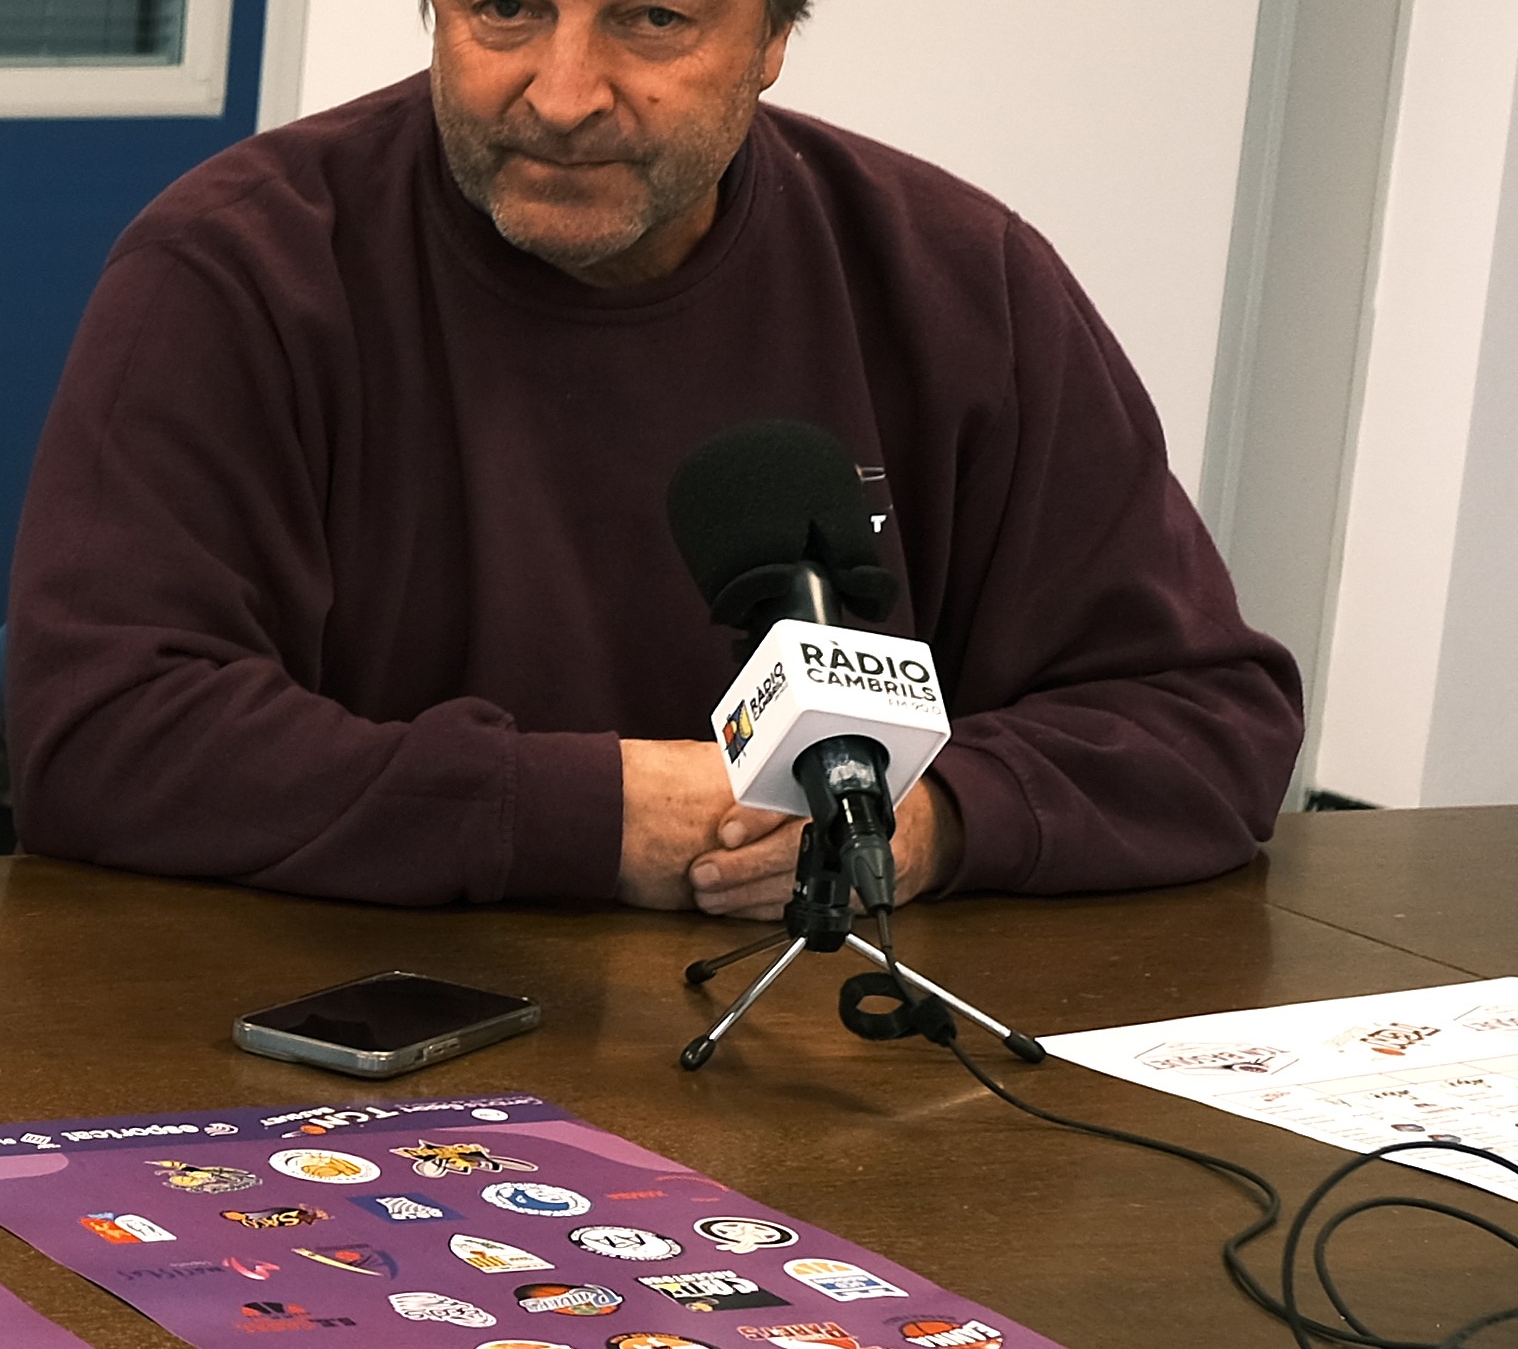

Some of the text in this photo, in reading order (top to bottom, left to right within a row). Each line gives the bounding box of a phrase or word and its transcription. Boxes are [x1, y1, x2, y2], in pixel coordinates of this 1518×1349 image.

[800, 640, 931, 684] RÀDIO
[750, 661, 784, 714] RÀDIO
[807, 668, 937, 702] CAMBRILS
[62, 1124, 201, 1143] esportcat
[904, 1319, 1001, 1349] EANNA
